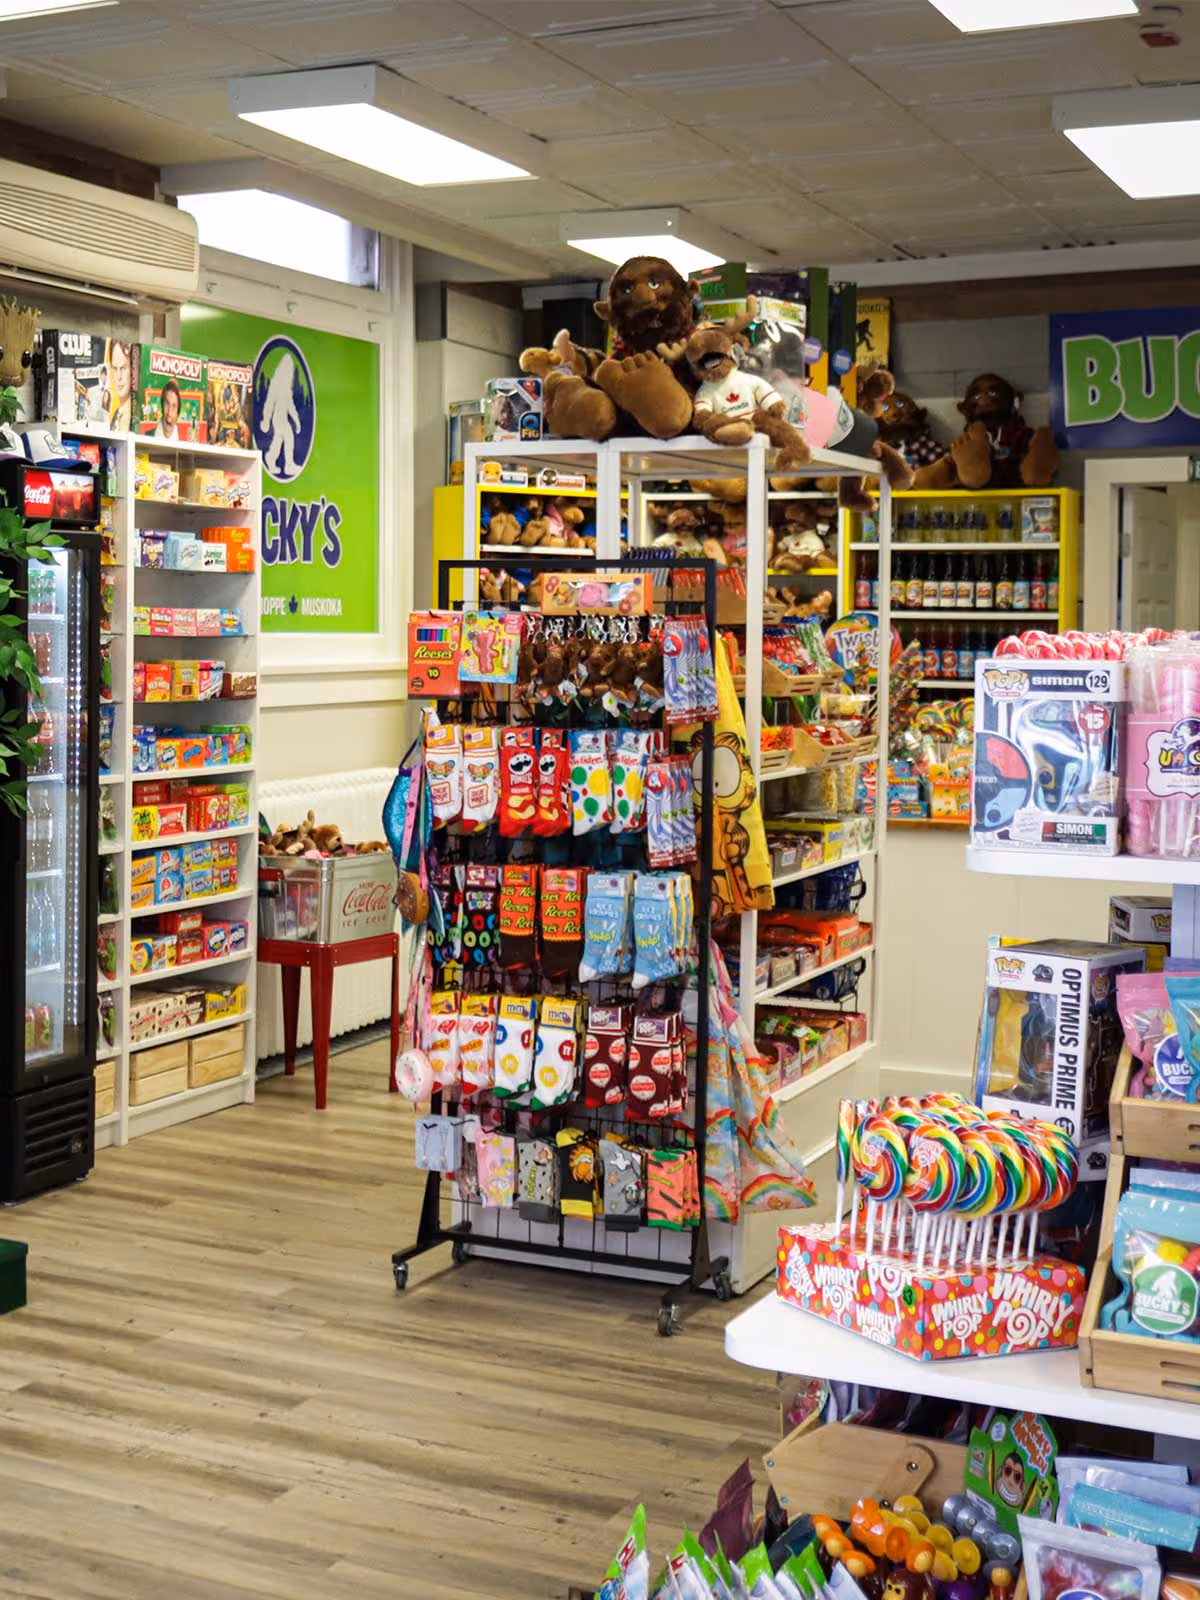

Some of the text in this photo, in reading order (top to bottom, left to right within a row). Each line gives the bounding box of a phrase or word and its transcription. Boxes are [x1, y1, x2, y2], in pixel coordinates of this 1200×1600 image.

[59, 333, 92, 356] CLUE
[151, 354, 201, 379] MONOPOLY
[208, 366, 251, 383] MONOPOLY
[260, 495, 343, 569] CKY'S
[301, 598, 342, 616] MUSKOKA
[834, 629, 894, 647] Twist
[428, 667, 439, 677] 10
[982, 669, 1109, 691] POP! simon 129
[1055, 822, 1093, 835] SIMON
[342, 919, 357, 928] ICE
[994, 955, 1025, 976] POP!
[1054, 967, 1082, 1111] OPTIMUS PRIME
[814, 1263, 860, 1295] WHIRLY
[822, 1284, 853, 1319] POP
[931, 1290, 988, 1327] WHIRLY
[992, 1272, 1074, 1334] WHIRLY
[855, 1303, 898, 1340] WHIRLY
[943, 1312, 982, 1346] POP
[992, 1300, 1050, 1349] POP
